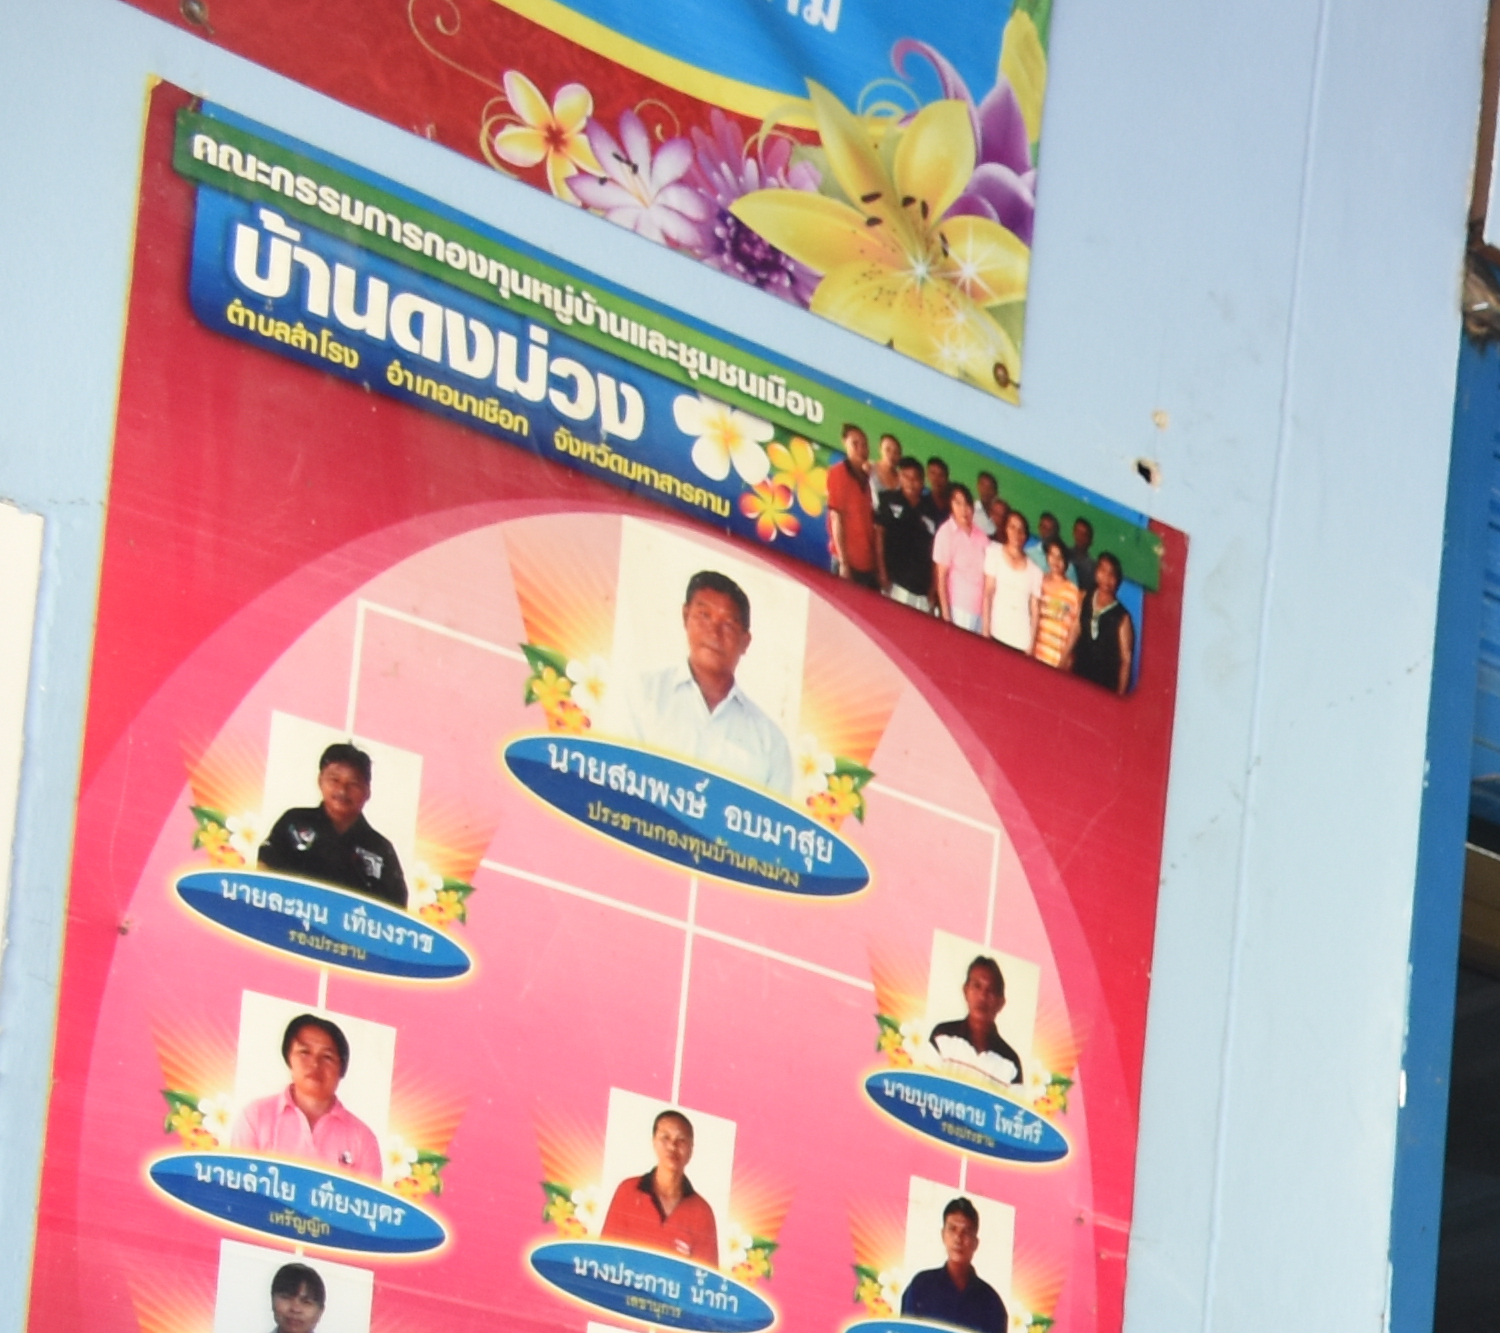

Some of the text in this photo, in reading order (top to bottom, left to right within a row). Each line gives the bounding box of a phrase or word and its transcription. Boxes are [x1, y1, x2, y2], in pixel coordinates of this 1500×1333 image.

[192, 133, 825, 425] คณะกรรมการกองทุนหมู่บ้านและชุมชนเมือง
[233, 207, 645, 442] บ้านดงม่วง
[226, 298, 731, 518] ตำบลสำโรง อำเภอนาเชือก จังหวัดมหาสารคาม
[548, 742, 834, 872] นายสมพงษ์ อบมาสุย
[588, 799, 800, 889] ประธานกองทุนบ้านดงม่วง
[220, 878, 329, 931] นายละมุน
[195, 1161, 297, 1202] นายลำใย
[573, 1255, 681, 1299] นางประกาย
